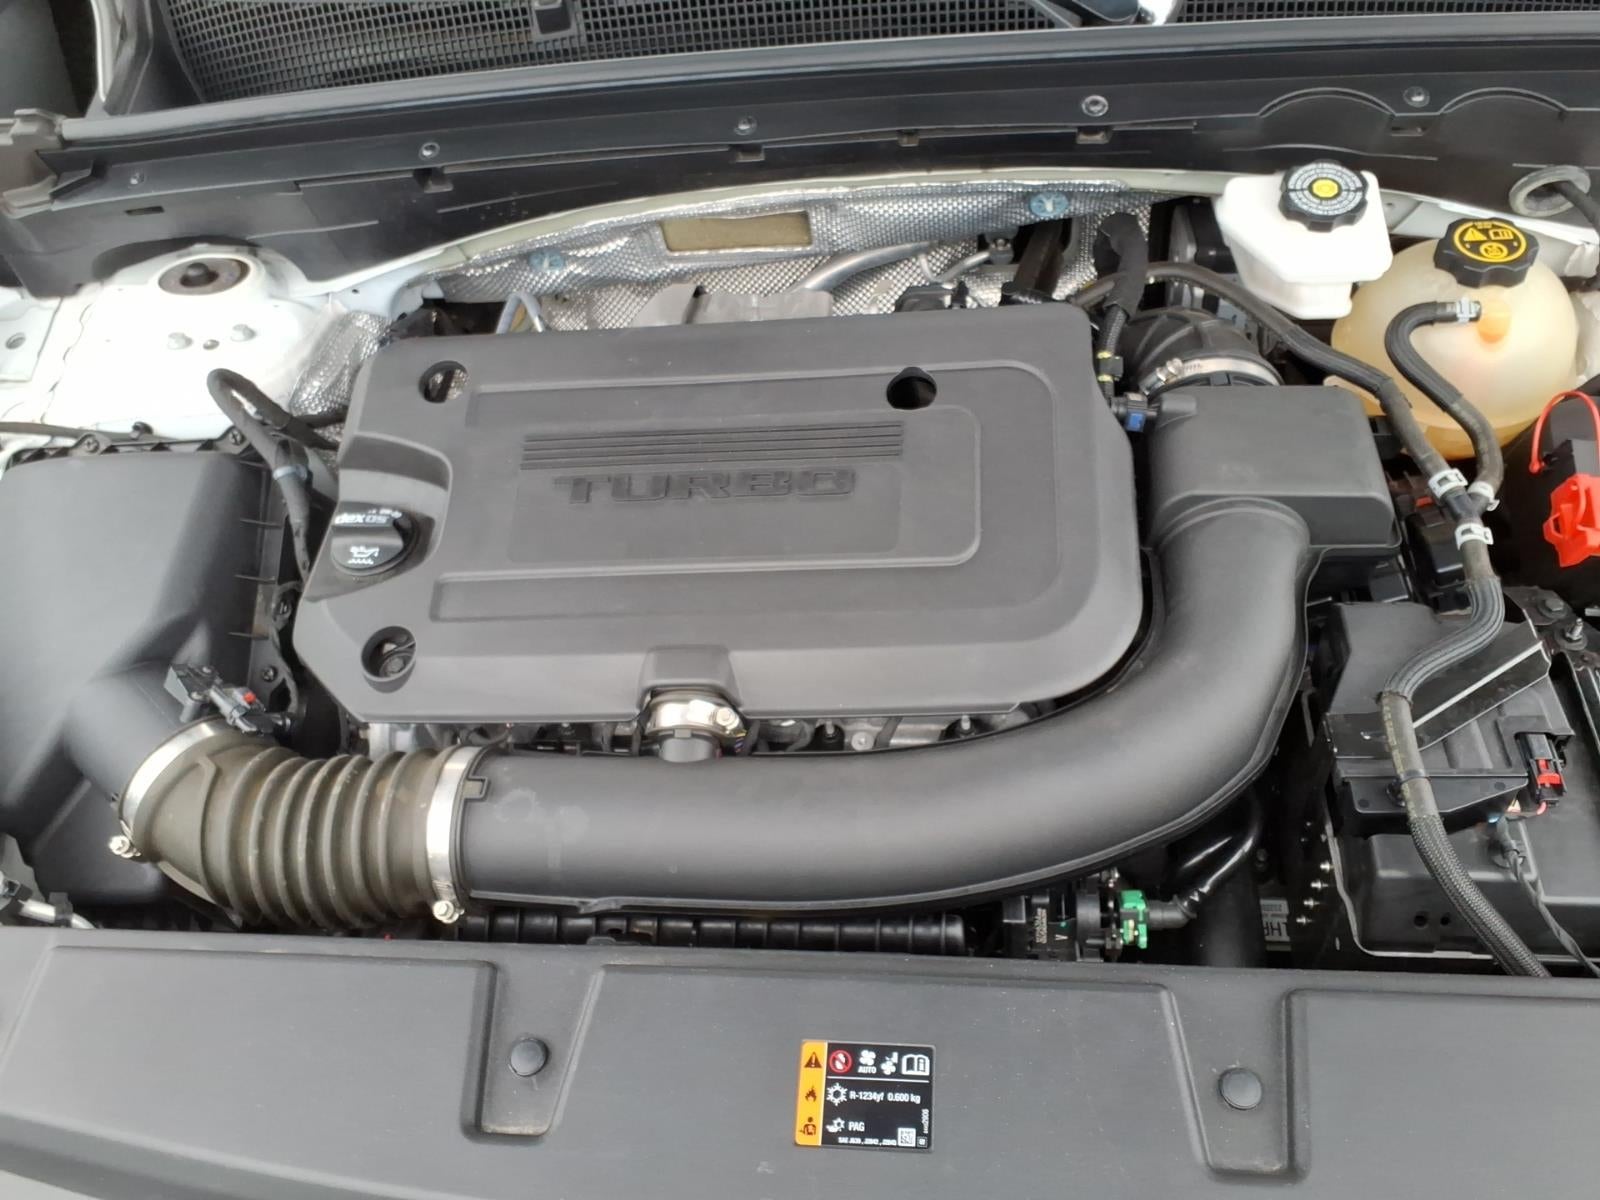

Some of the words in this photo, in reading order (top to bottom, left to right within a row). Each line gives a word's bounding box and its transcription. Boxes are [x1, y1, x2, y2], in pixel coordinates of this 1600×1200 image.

[554, 468, 856, 504] TURBO
[858, 1065, 876, 1074] AUTO
[849, 1090, 884, 1103] R-1234yf
[887, 1092, 909, 1103] 0.600
[910, 1093, 921, 1105] kg
[848, 1121, 865, 1132] PAG
